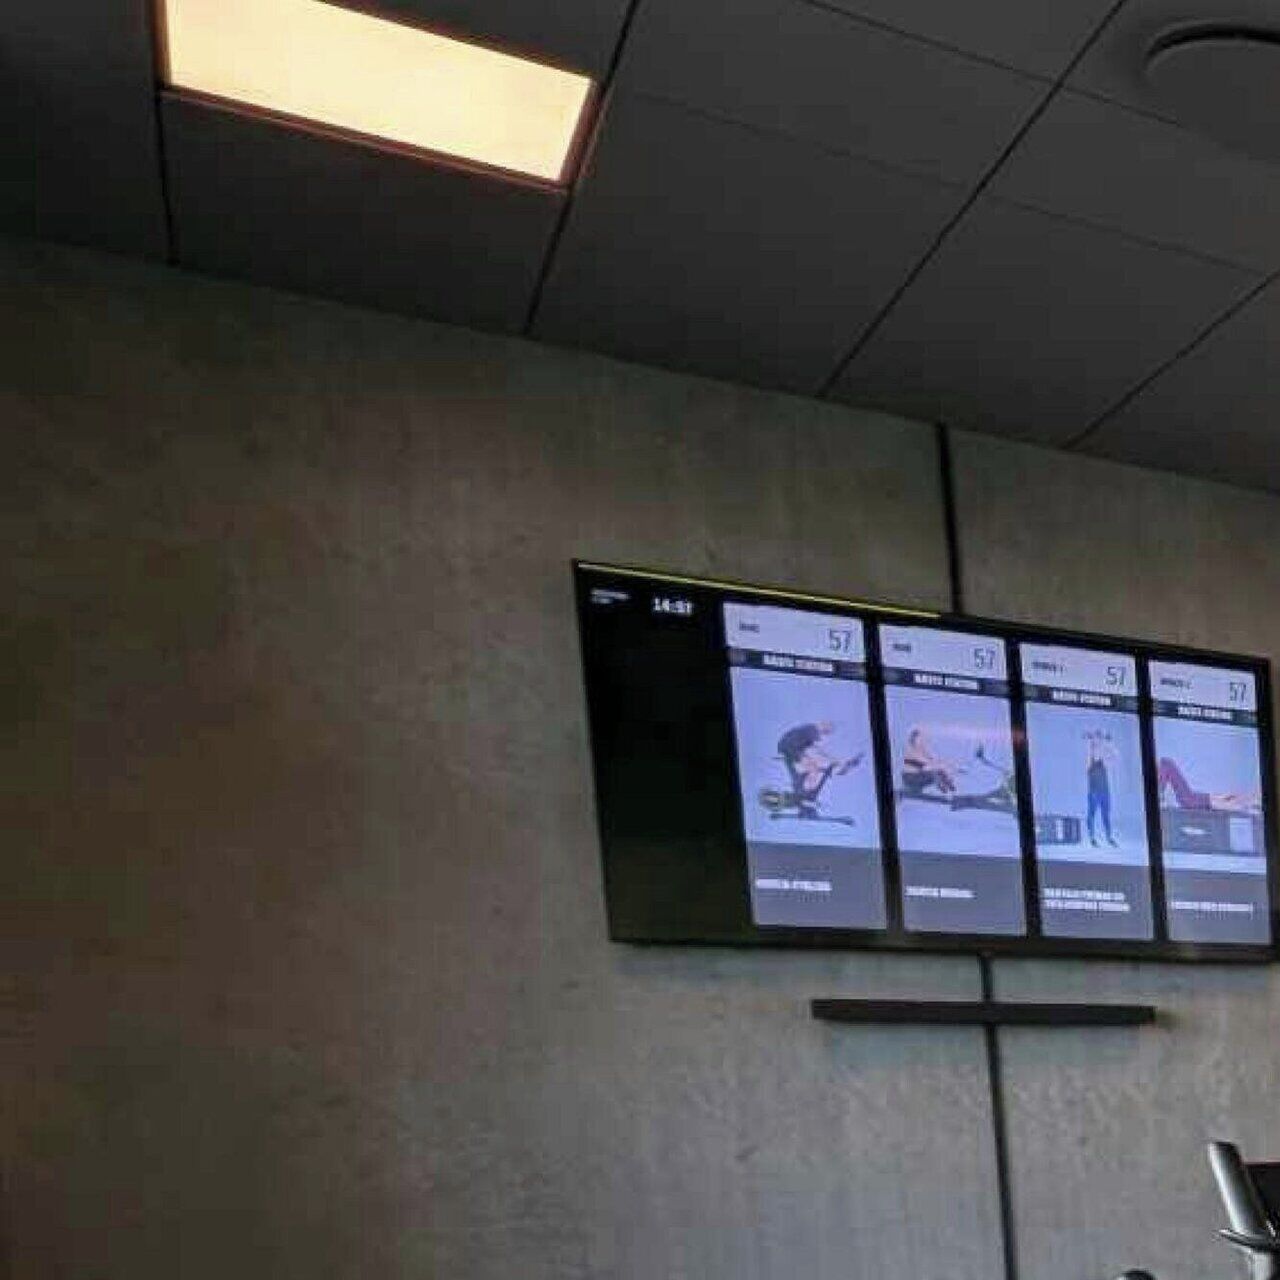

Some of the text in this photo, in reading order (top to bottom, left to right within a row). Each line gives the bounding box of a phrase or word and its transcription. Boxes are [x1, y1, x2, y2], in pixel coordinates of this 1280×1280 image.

[828, 630, 851, 653] 57
[974, 647, 996, 670] 57
[1105, 665, 1127, 686] 57
[1228, 681, 1247, 702] 57
